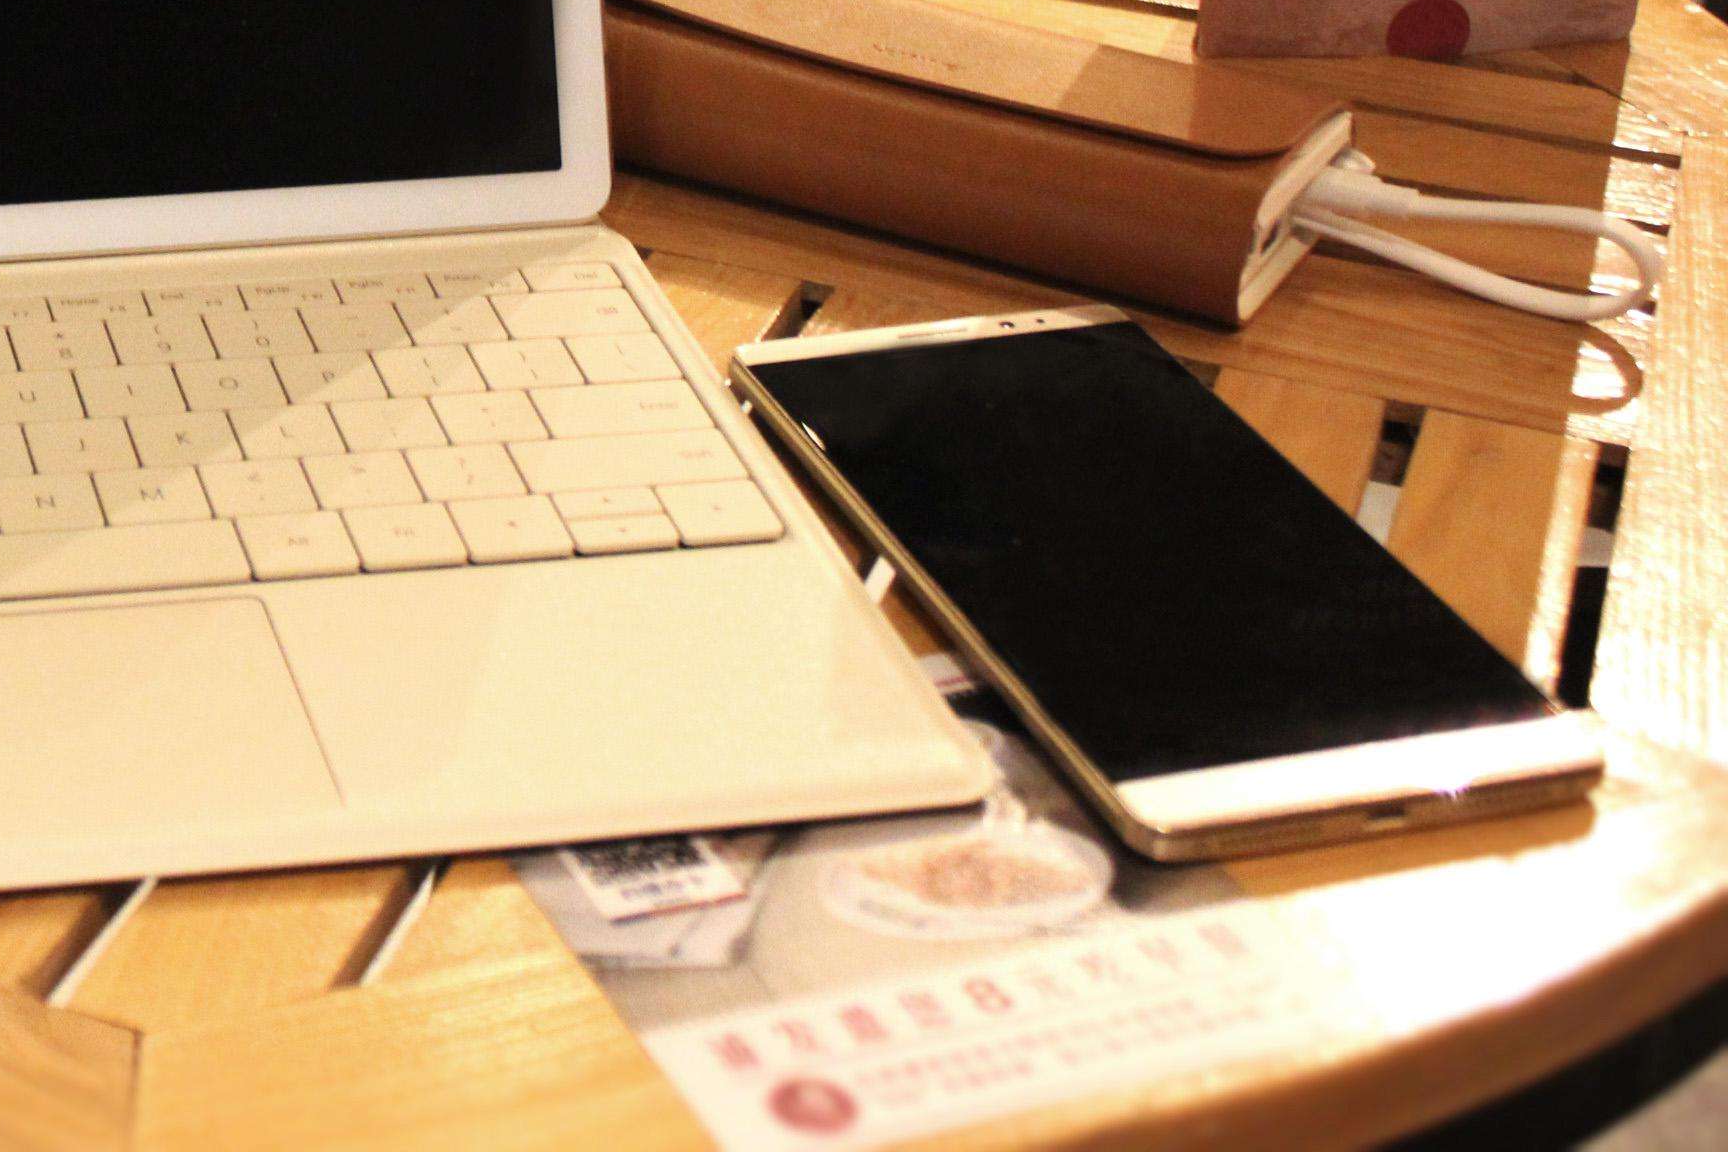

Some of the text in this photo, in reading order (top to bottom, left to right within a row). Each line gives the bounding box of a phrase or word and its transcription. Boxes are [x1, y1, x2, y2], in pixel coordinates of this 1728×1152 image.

[218, 376, 240, 391] O
[321, 369, 336, 384] P
[18, 389, 37, 403] U
[175, 431, 192, 446] K
[279, 425, 294, 439] L
[139, 487, 165, 501] M
[34, 495, 57, 509] N
